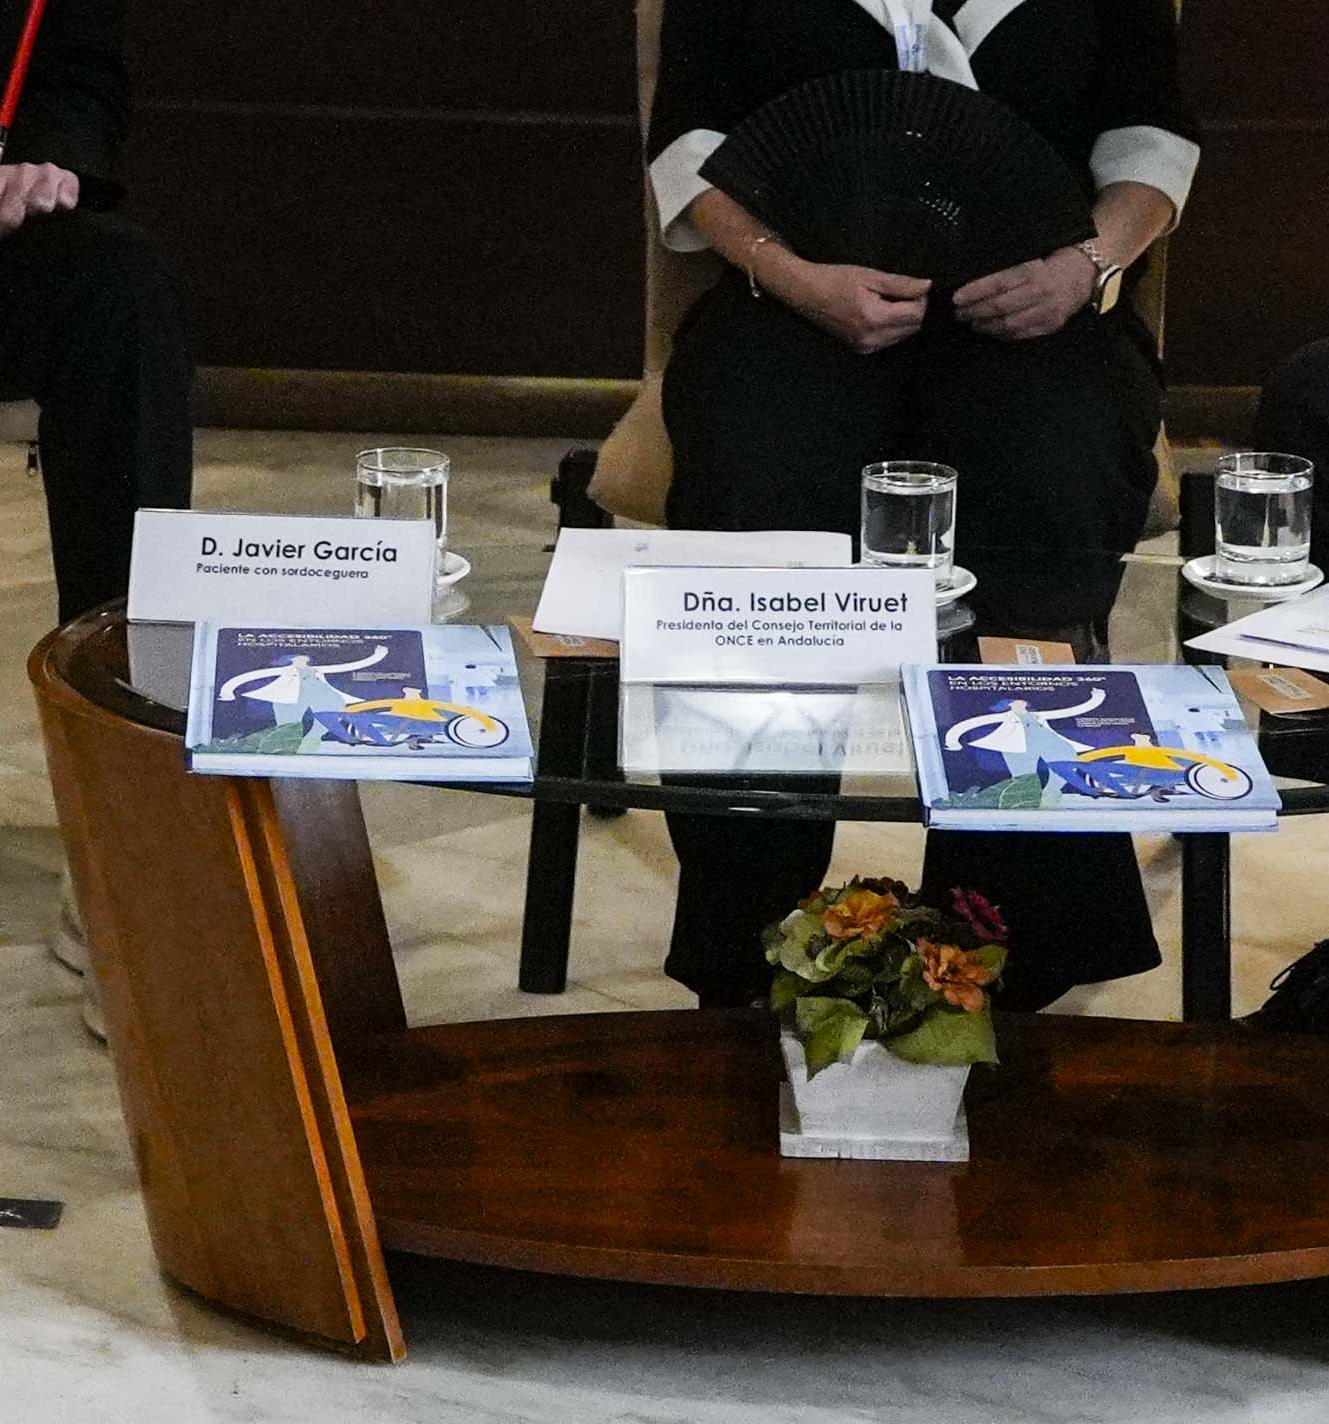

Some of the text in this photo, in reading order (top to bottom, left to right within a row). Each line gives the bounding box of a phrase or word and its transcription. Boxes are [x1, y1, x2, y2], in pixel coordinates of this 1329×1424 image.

[201, 537, 397, 562] D. Javier García
[196, 563, 369, 580] Paciente con sordoceguera
[683, 591, 908, 613] Dña. Isabel Viruet
[656, 619, 903, 633] Presidenta del Consejo Territorial de la
[715, 635, 754, 646] ONCE
[757, 637, 774, 646] en
